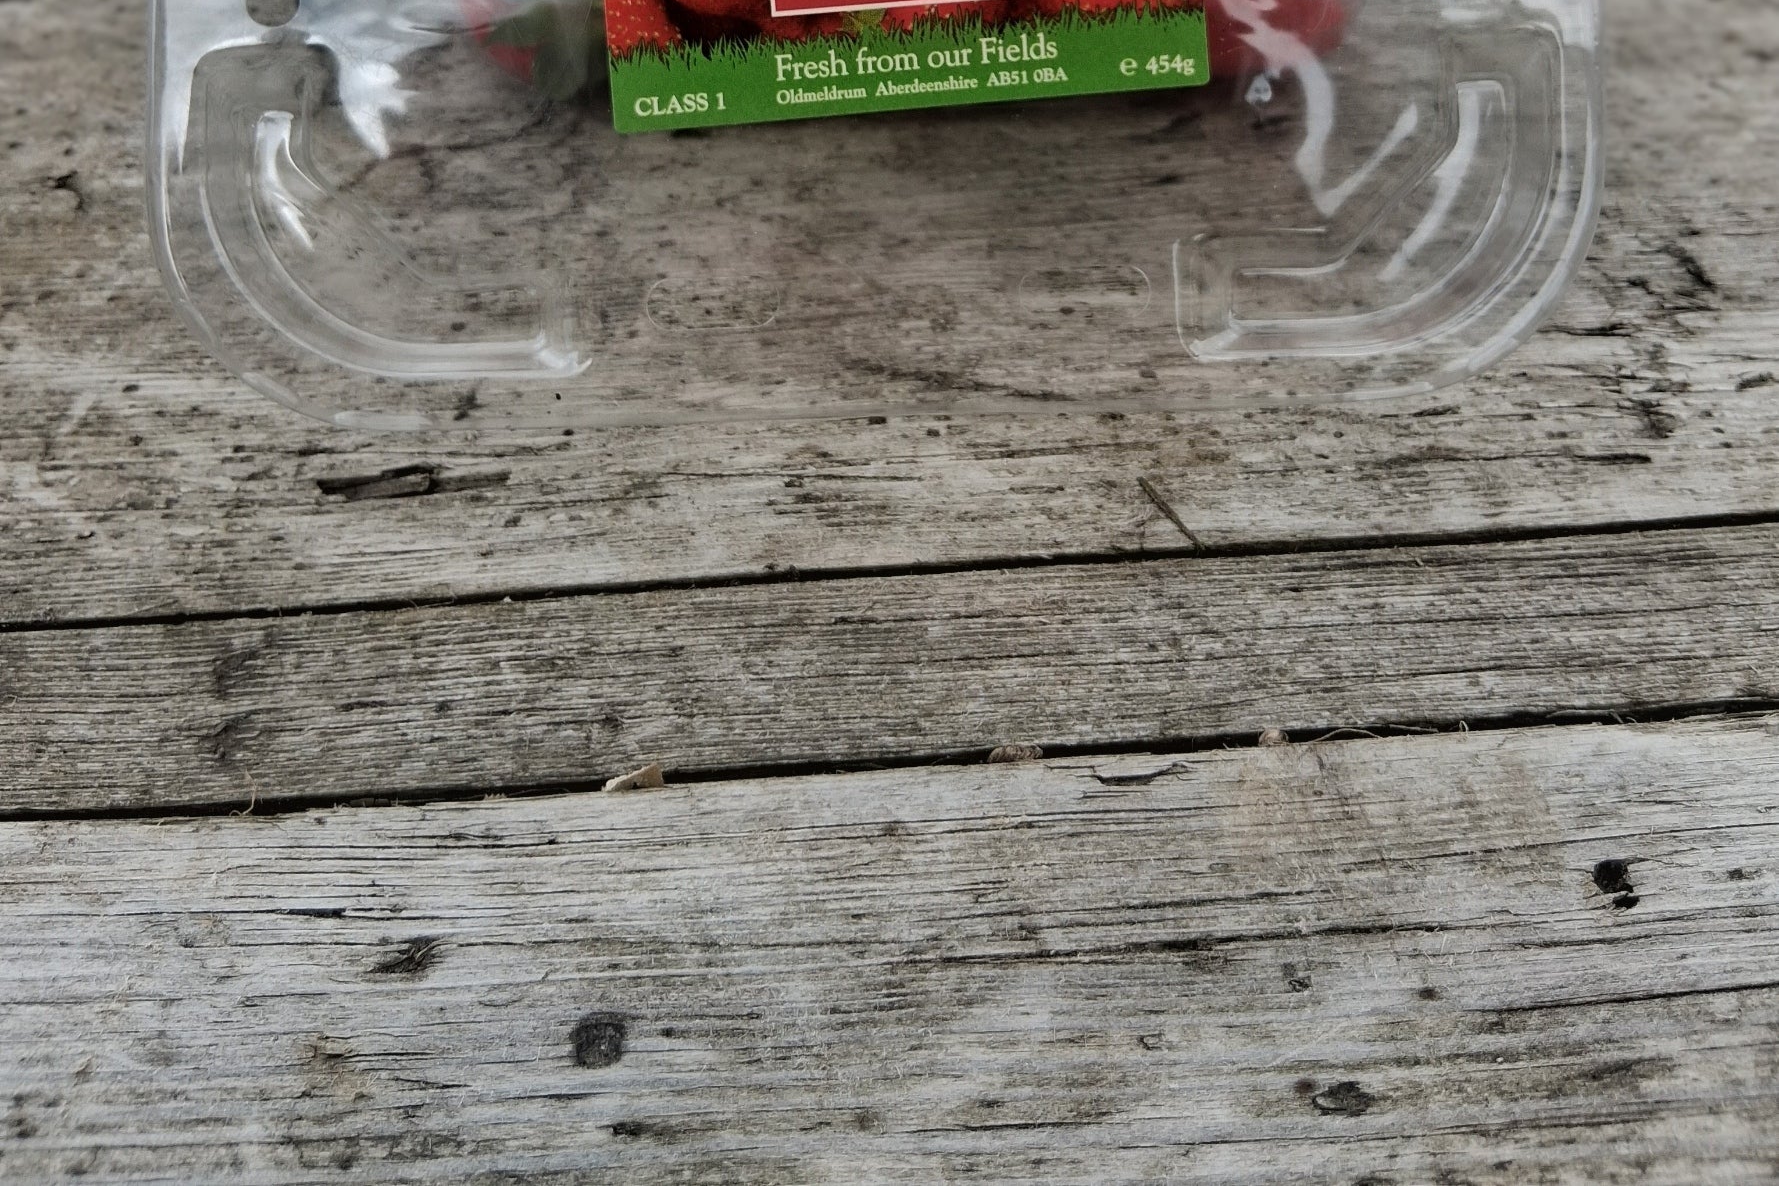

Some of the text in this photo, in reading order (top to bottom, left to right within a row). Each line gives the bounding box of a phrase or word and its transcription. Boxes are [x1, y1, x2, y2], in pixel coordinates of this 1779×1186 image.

[774, 32, 1058, 81] Fresh from our Fields
[1145, 54, 1195, 76] 454g
[776, 84, 867, 105] Oldmeldrum
[875, 75, 978, 97] Aberdeenshire
[986, 70, 1029, 87] AB51
[634, 92, 726, 117] CLASS 1
